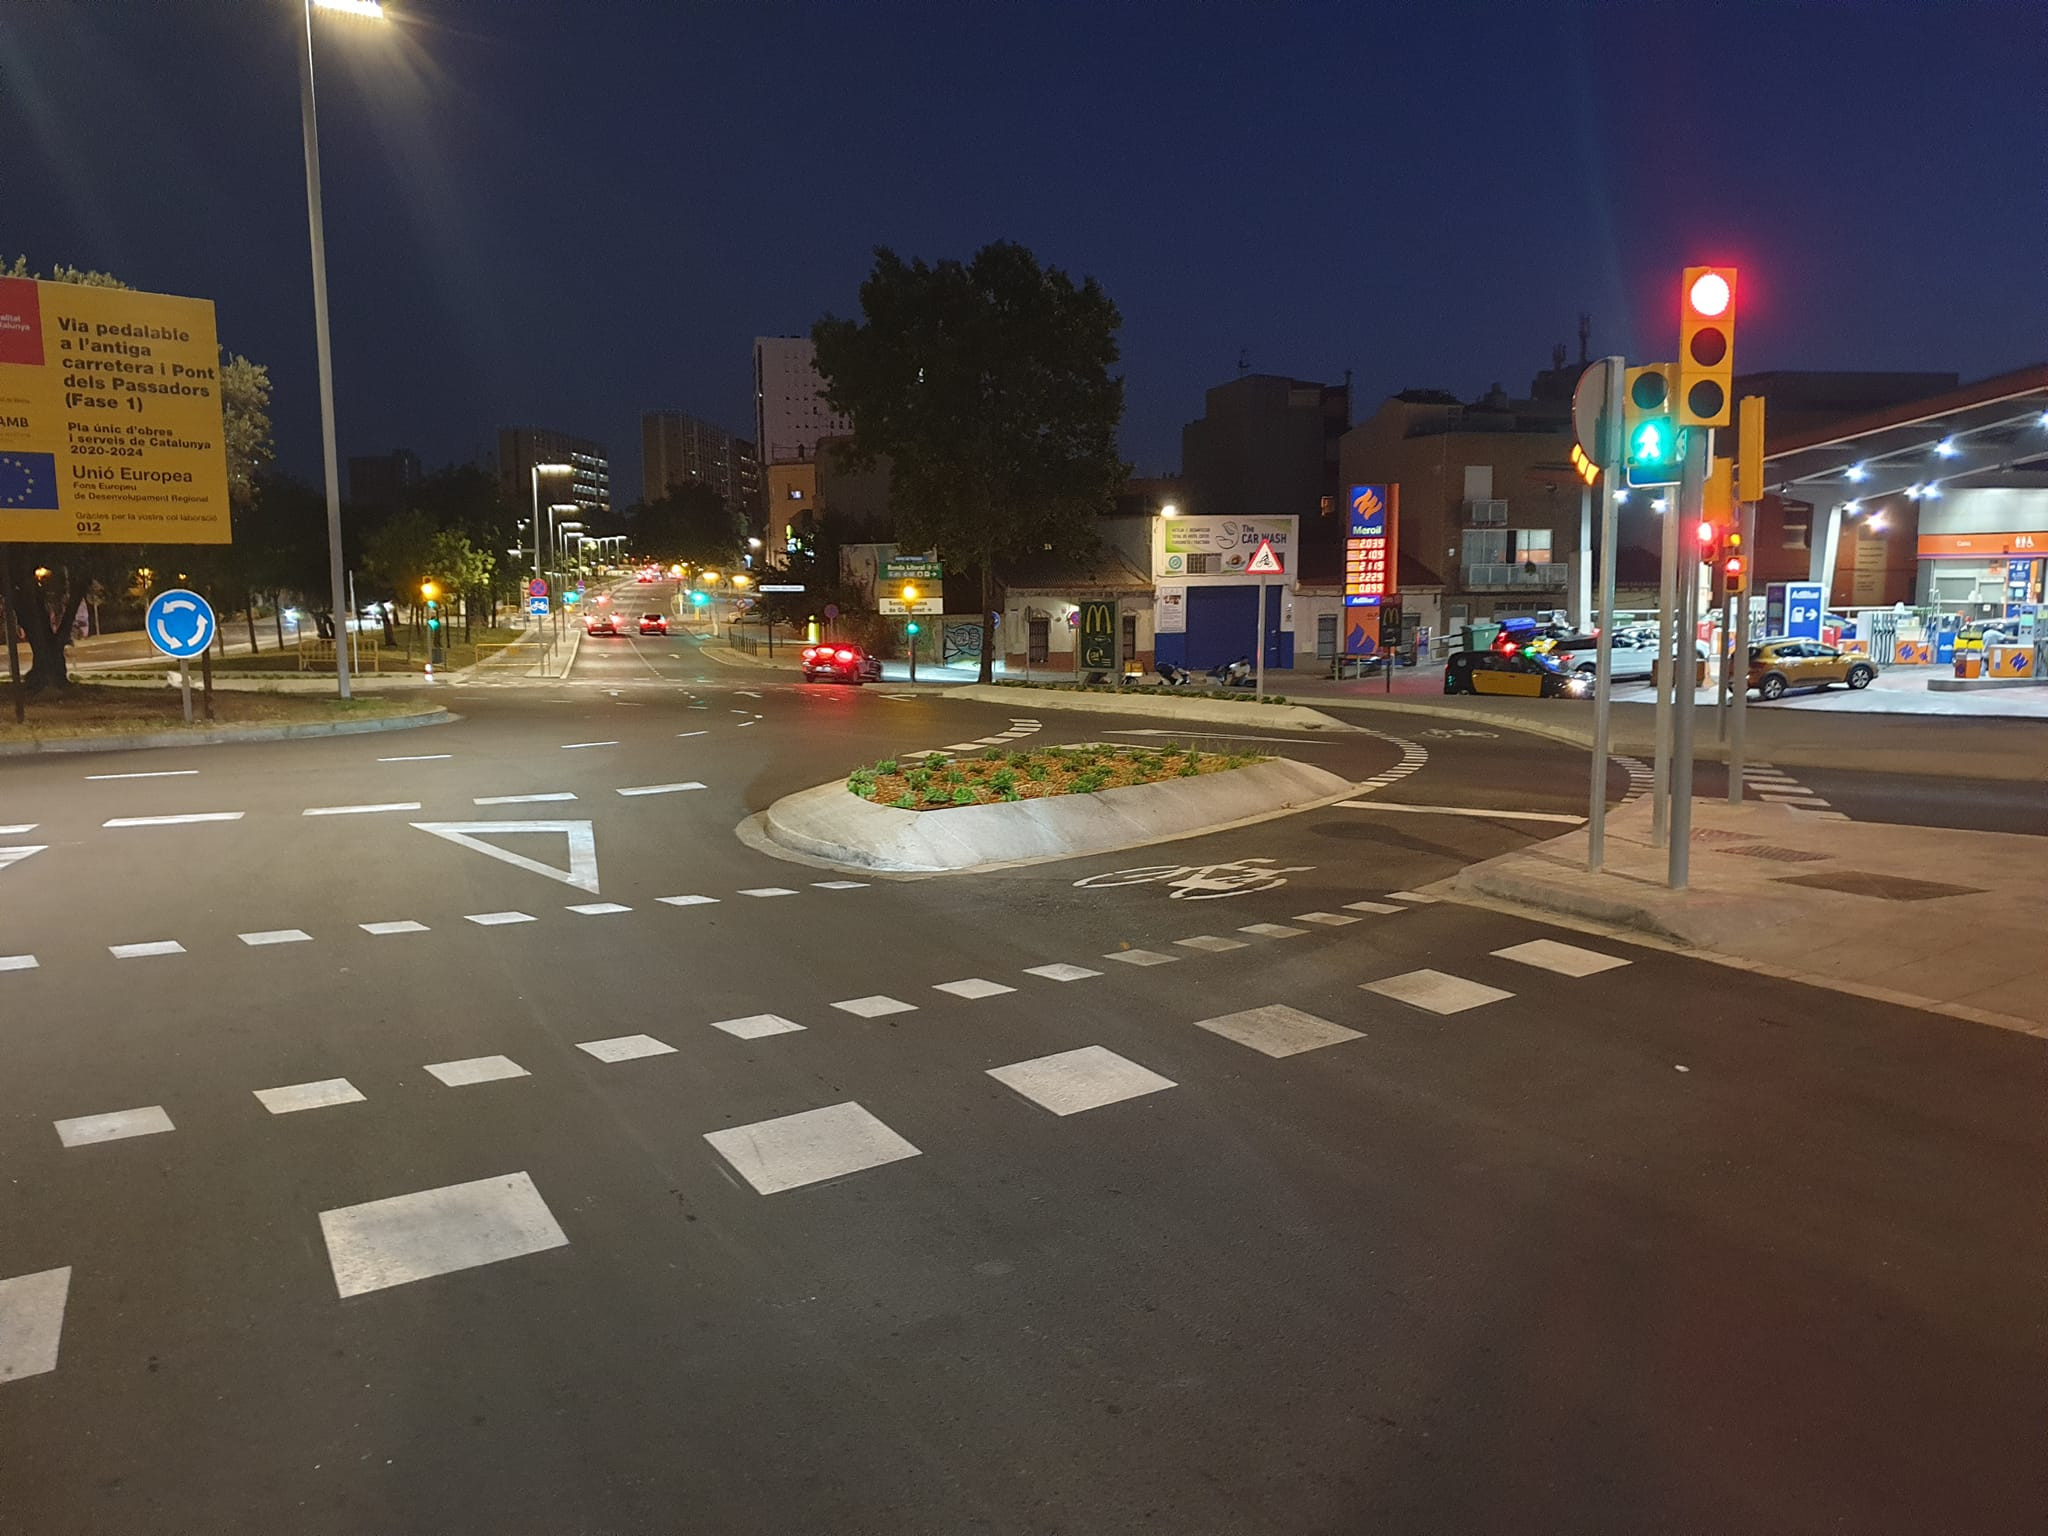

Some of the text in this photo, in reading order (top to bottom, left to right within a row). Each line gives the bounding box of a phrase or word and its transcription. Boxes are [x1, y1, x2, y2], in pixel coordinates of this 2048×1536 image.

[57, 317, 190, 342] Via pedalable
[60, 337, 152, 357] a l'antiga
[62, 358, 215, 380] carretera i Pont
[63, 374, 210, 397] dels Passadors
[65, 392, 143, 413] (Fase 1)
[68, 421, 173, 436] Pla únic d'obres
[78, 436, 125, 445] serveis
[130, 437, 145, 446] de
[150, 438, 211, 450] Catalunya
[70, 445, 143, 457] 2020-2024
[72, 465, 193, 484] Unió Europea
[73, 482, 137, 491] Fons Europeu
[74, 492, 209, 504] de Desenvolupament Regional
[76, 511, 109, 520] Gràcies
[76, 522, 101, 532] 012
[1241, 524, 1255, 532] The
[1353, 525, 1382, 535] Meroil
[1242, 532, 1287, 544] CAR WASH
